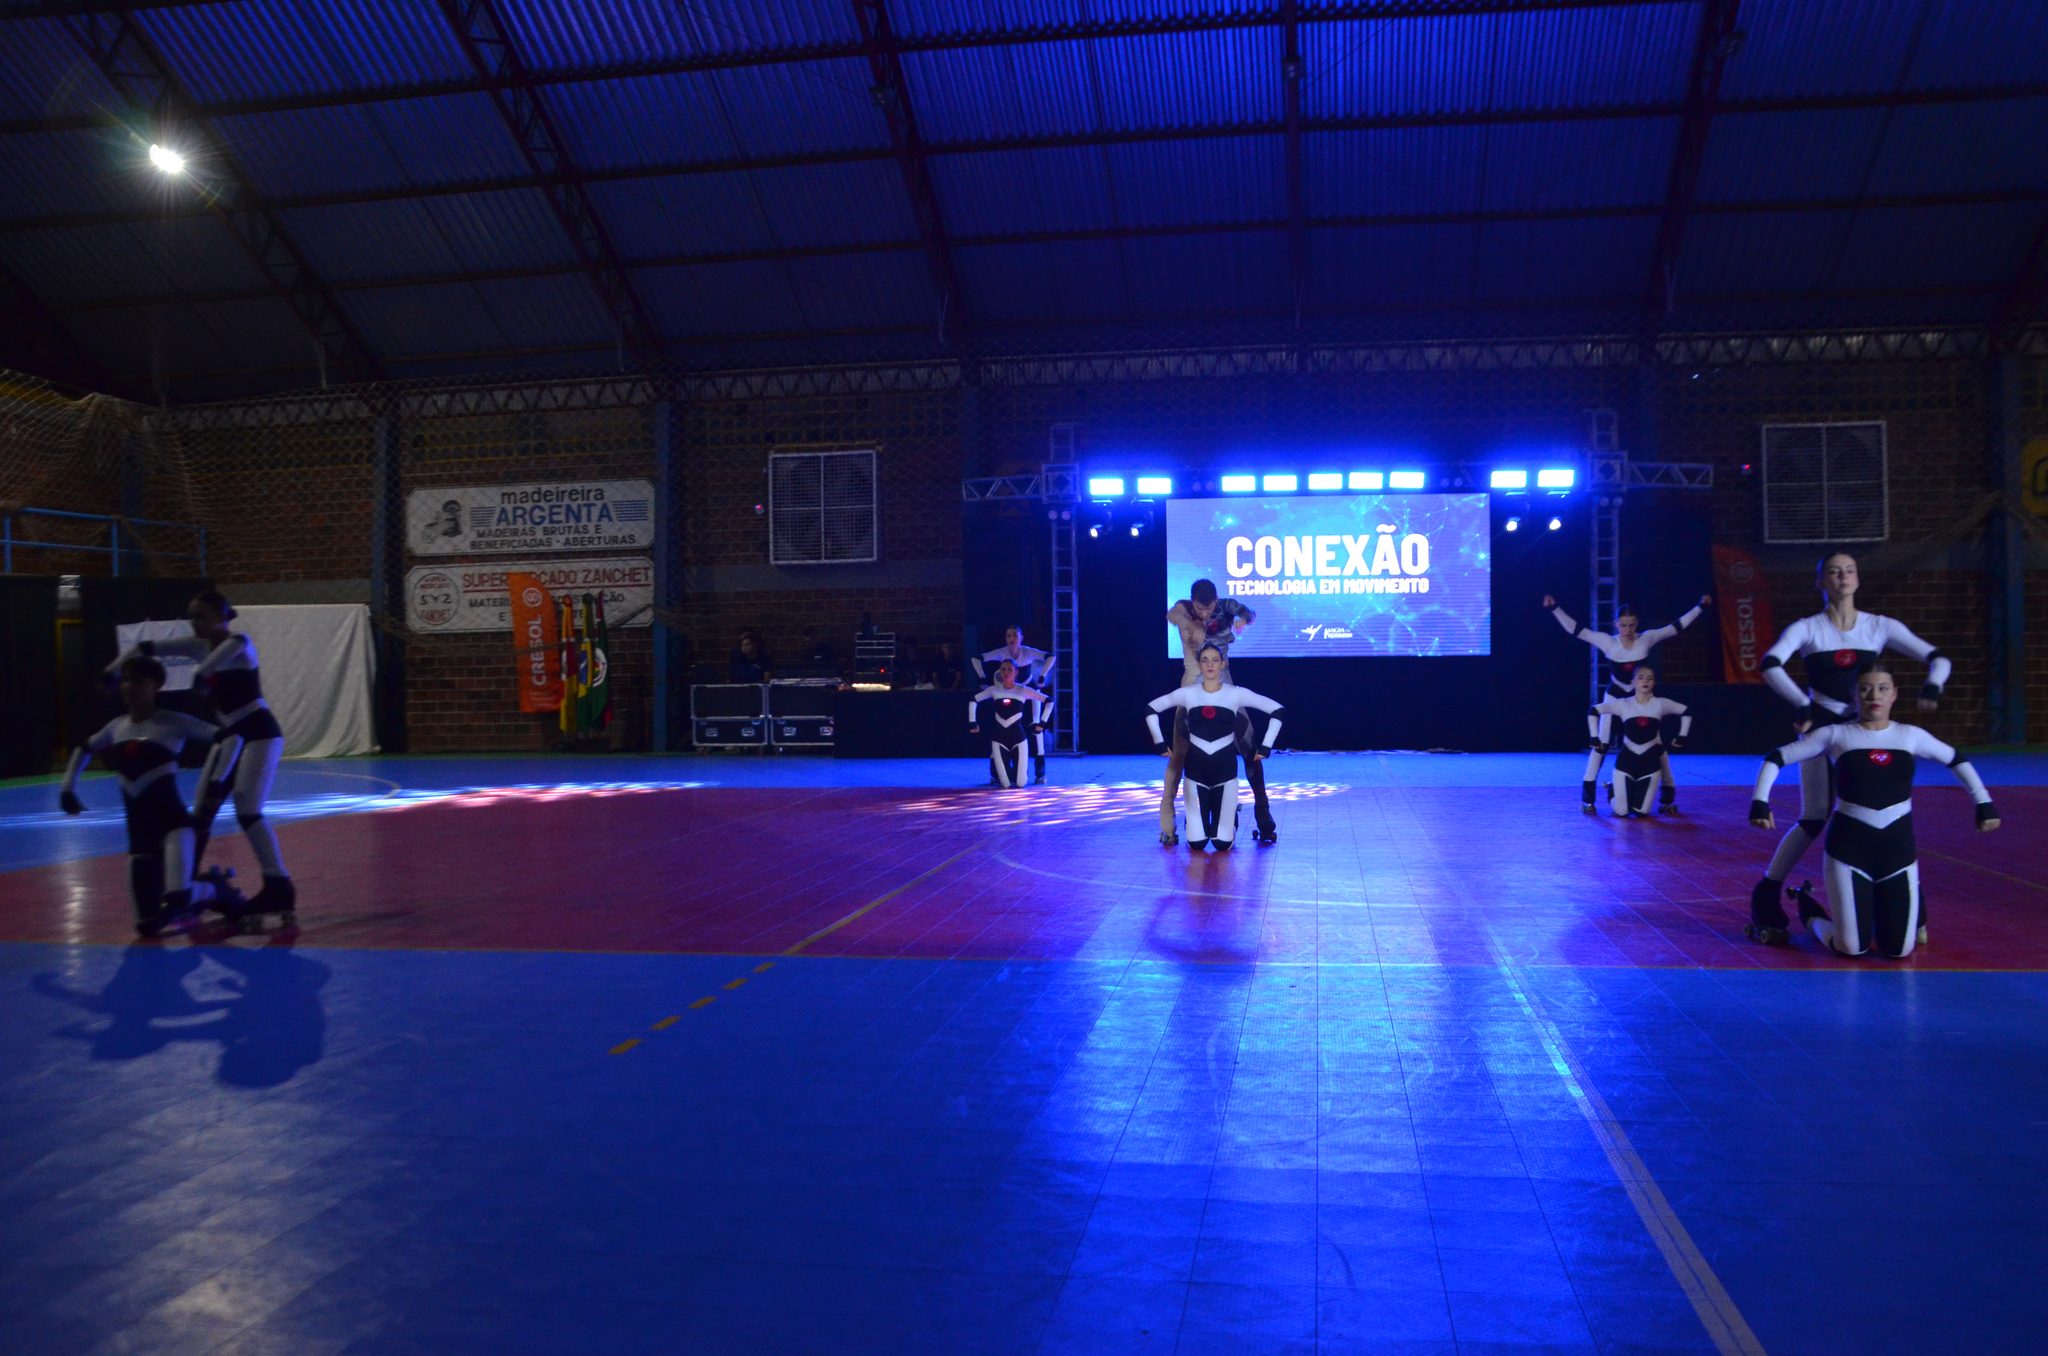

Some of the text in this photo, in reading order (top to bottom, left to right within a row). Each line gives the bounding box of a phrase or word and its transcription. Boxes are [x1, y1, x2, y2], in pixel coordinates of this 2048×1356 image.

[501, 486, 604, 504] madeireira
[496, 503, 613, 526] ARGENTA
[477, 524, 602, 539] MADEIRAS BRUTAS E
[470, 534, 636, 549] BENEFICIADAS ABERTURAS
[1226, 523, 1430, 578] CONEXÃO
[582, 567, 651, 584] ZANCHET
[1226, 577, 1430, 596] TECNOLOGIA EM MOVIMENTO
[1736, 592, 1757, 672] CRESOL
[527, 614, 546, 686] CRESOL
